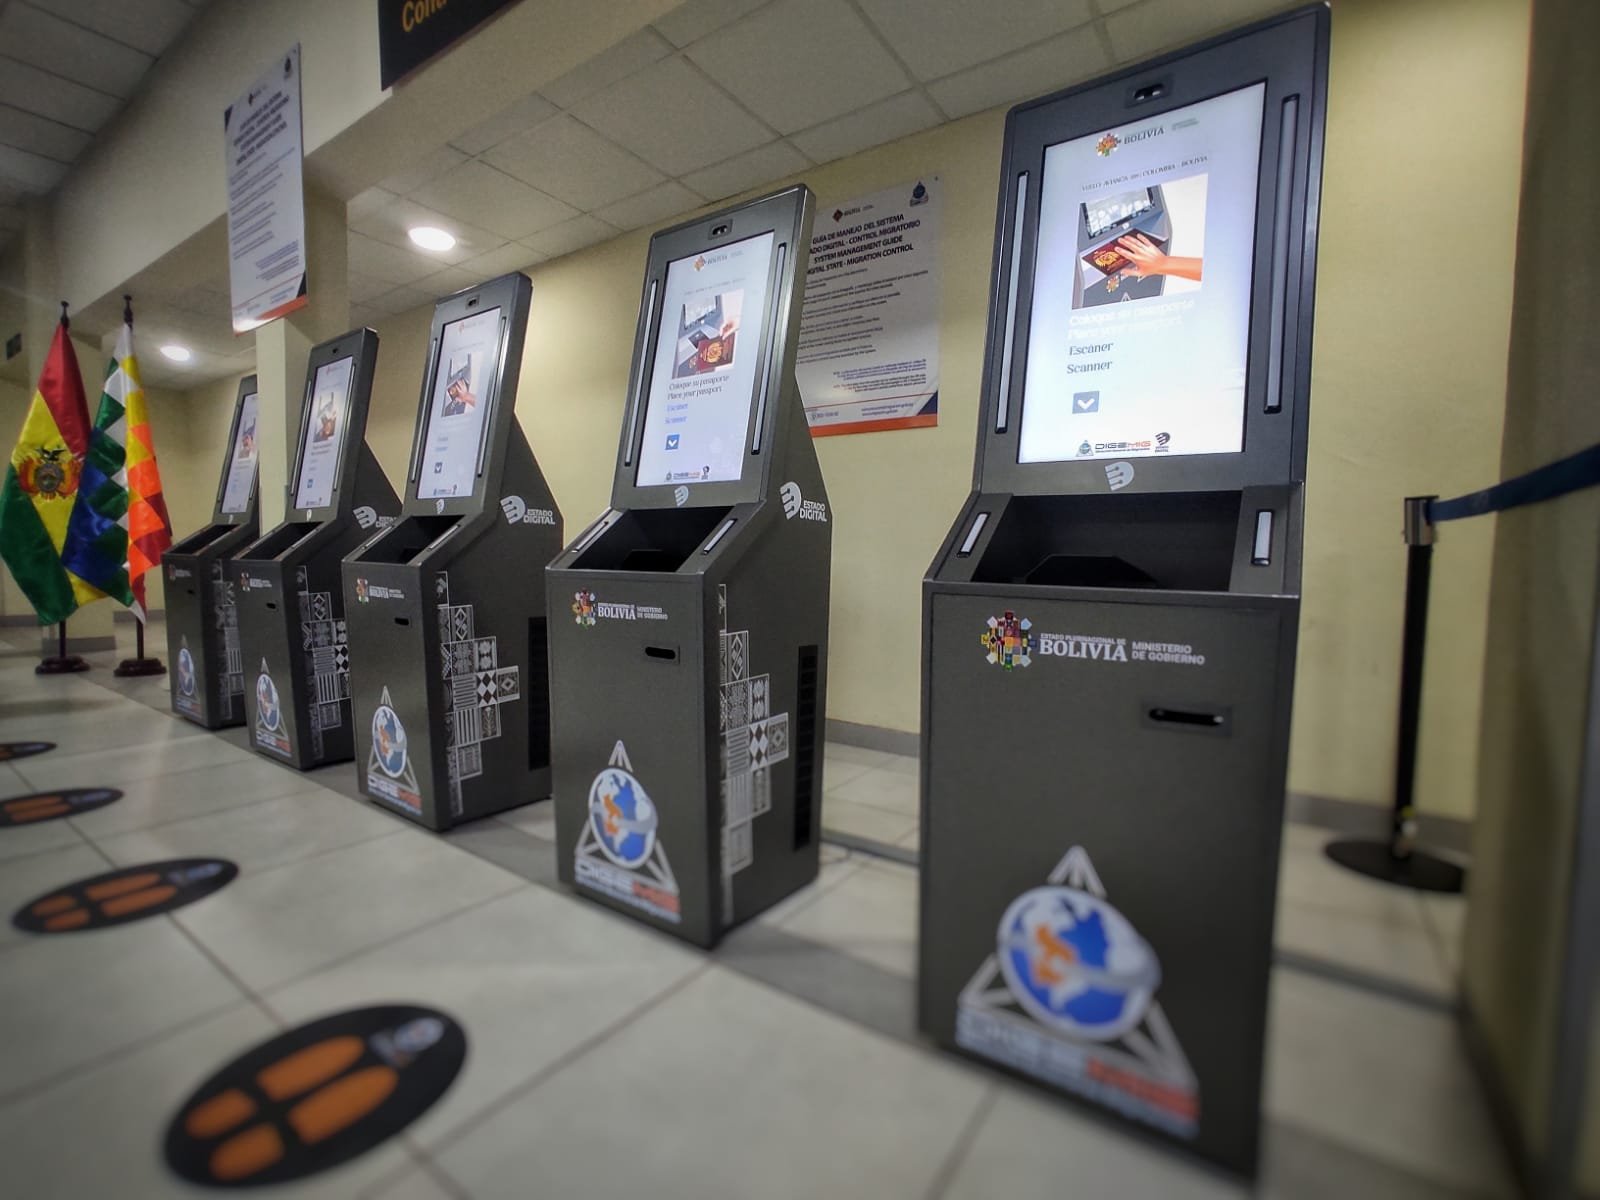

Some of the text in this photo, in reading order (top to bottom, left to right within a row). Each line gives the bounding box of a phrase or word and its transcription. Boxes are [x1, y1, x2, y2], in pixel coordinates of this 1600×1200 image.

[402, 0, 447, 32] Con
[1124, 127, 1164, 145] BOLIVIA
[837, 225, 862, 238] MANEJO
[864, 222, 875, 231] DEL
[876, 213, 904, 227] SISTEMA
[823, 240, 846, 251] DIGITAL
[849, 231, 878, 244] CONTROL
[879, 219, 920, 236] MIGRATORIO
[814, 234, 903, 264] SYSTEM MANAGEMENT GUIDE
[826, 260, 843, 271] STATE
[847, 250, 881, 266] MIGRATION
[882, 242, 914, 257] CONTROL
[1066, 360, 1113, 374] Scanner
[527, 508, 553, 517] ESTADO
[803, 500, 826, 512] ESTADO
[523, 514, 556, 526] DIGITAL
[800, 507, 827, 522] DIGITAL
[597, 606, 636, 620] BOLIVIA
[1040, 632, 1065, 640] ESTADO
[1116, 638, 1126, 646] DE
[1039, 638, 1128, 662] BOLIVIA
[1132, 641, 1192, 655] MINISTERIO
[1132, 650, 1206, 666] DE GOBIERNO
